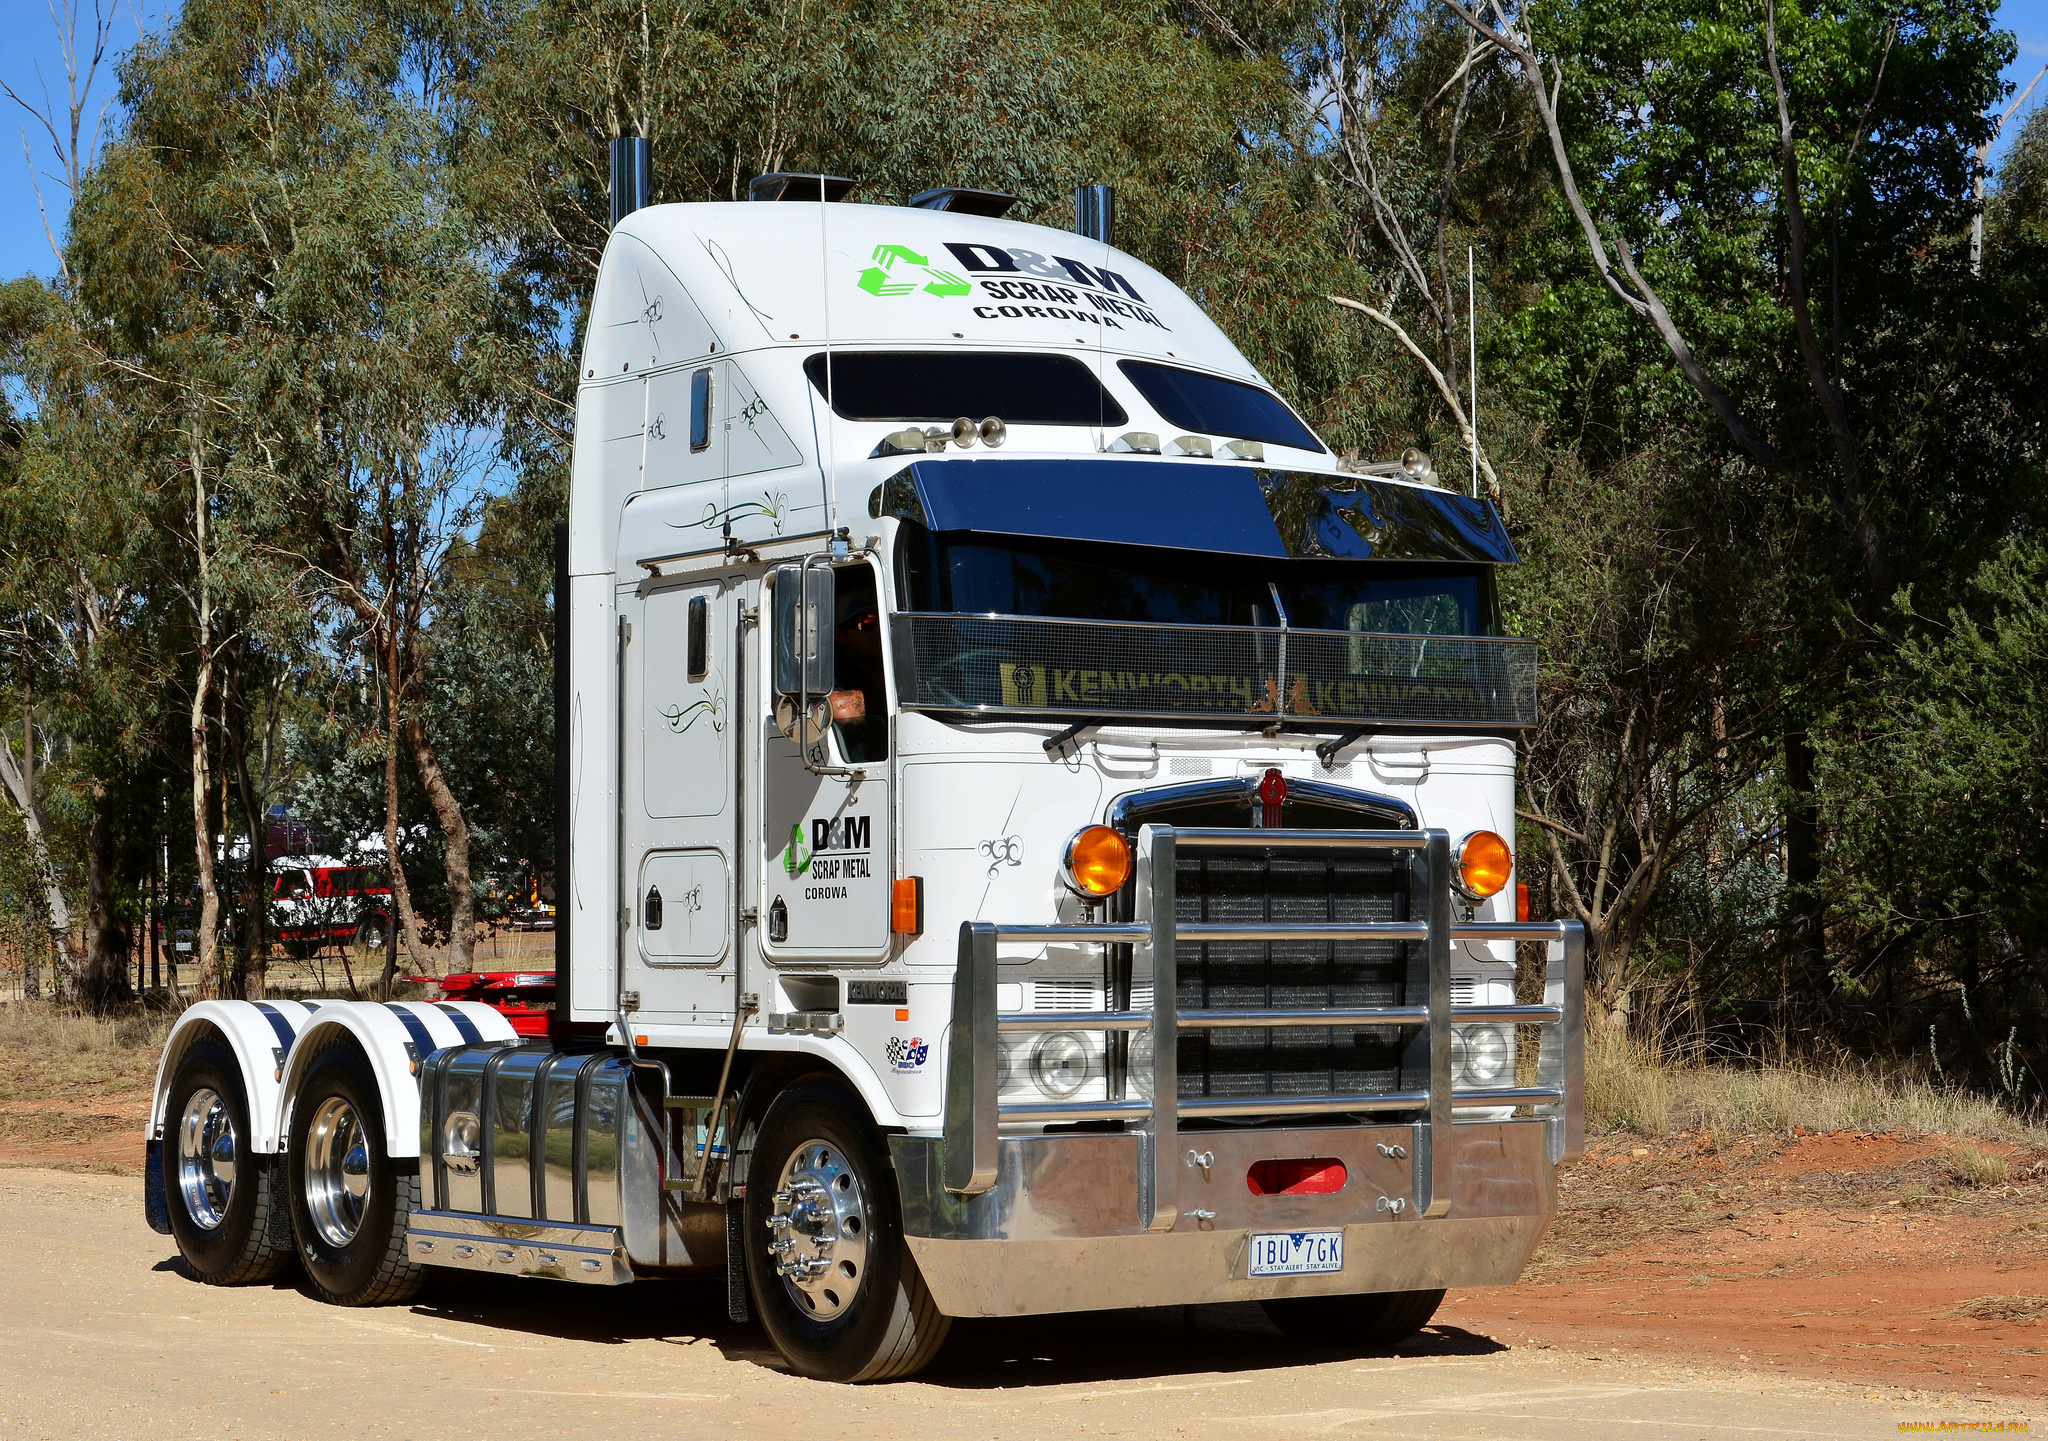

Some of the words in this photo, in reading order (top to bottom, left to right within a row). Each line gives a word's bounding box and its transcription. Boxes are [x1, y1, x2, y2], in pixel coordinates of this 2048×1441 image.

[942, 242, 1148, 304] D&M
[972, 305, 1125, 330] COROWA
[979, 280, 1078, 306] SCRAP
[1085, 291, 1173, 332] METAL
[812, 816, 871, 851] D&M
[812, 859, 840, 880] SCRAP
[842, 858, 871, 879] METAL
[805, 886, 848, 900] COROWA
[848, 980, 907, 1000] KENWORTH
[1257, 1239, 1290, 1265] 1BU
[1305, 1237, 1339, 1263] 7GK
